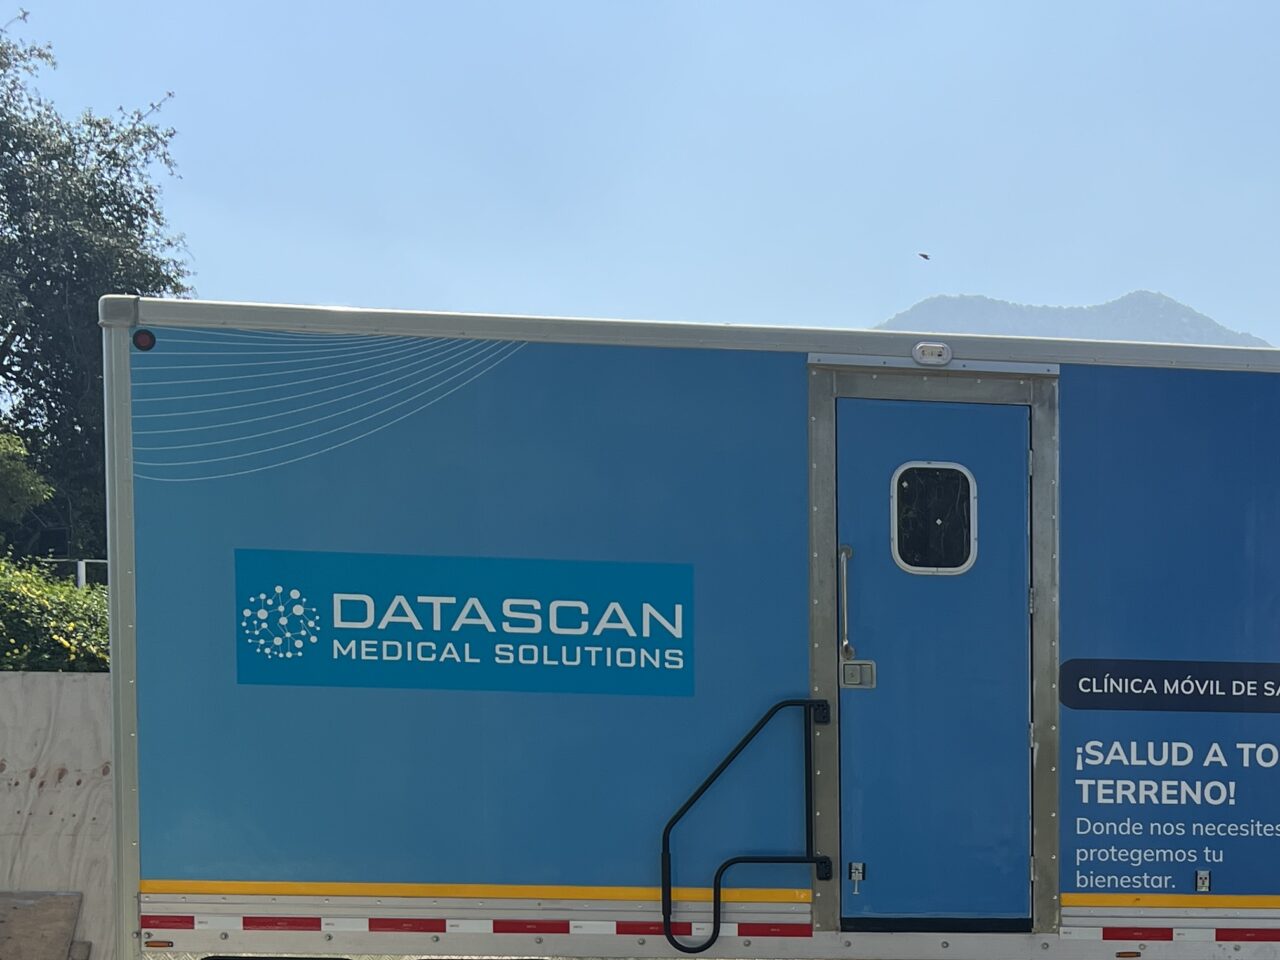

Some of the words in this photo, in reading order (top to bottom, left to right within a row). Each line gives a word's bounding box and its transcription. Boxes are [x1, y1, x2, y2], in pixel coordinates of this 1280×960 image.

[333, 593, 684, 638] DATASCAN
[333, 639, 481, 663] MEDICAL
[495, 644, 684, 669] SOLUTIONS
[1078, 673, 1158, 694] CLÍNICA
[1164, 675, 1226, 695] MÓVIL
[1232, 680, 1258, 696] DE
[1076, 740, 1194, 771] ¡SALUD
[1203, 742, 1228, 767] A
[1075, 779, 1236, 805] TERRENO!
[1076, 817, 1143, 836] Donde
[1150, 822, 1186, 836] nos
[1076, 845, 1198, 867] protegemos
[1203, 846, 1223, 863] tu
[1076, 870, 1176, 889] bienestar.
